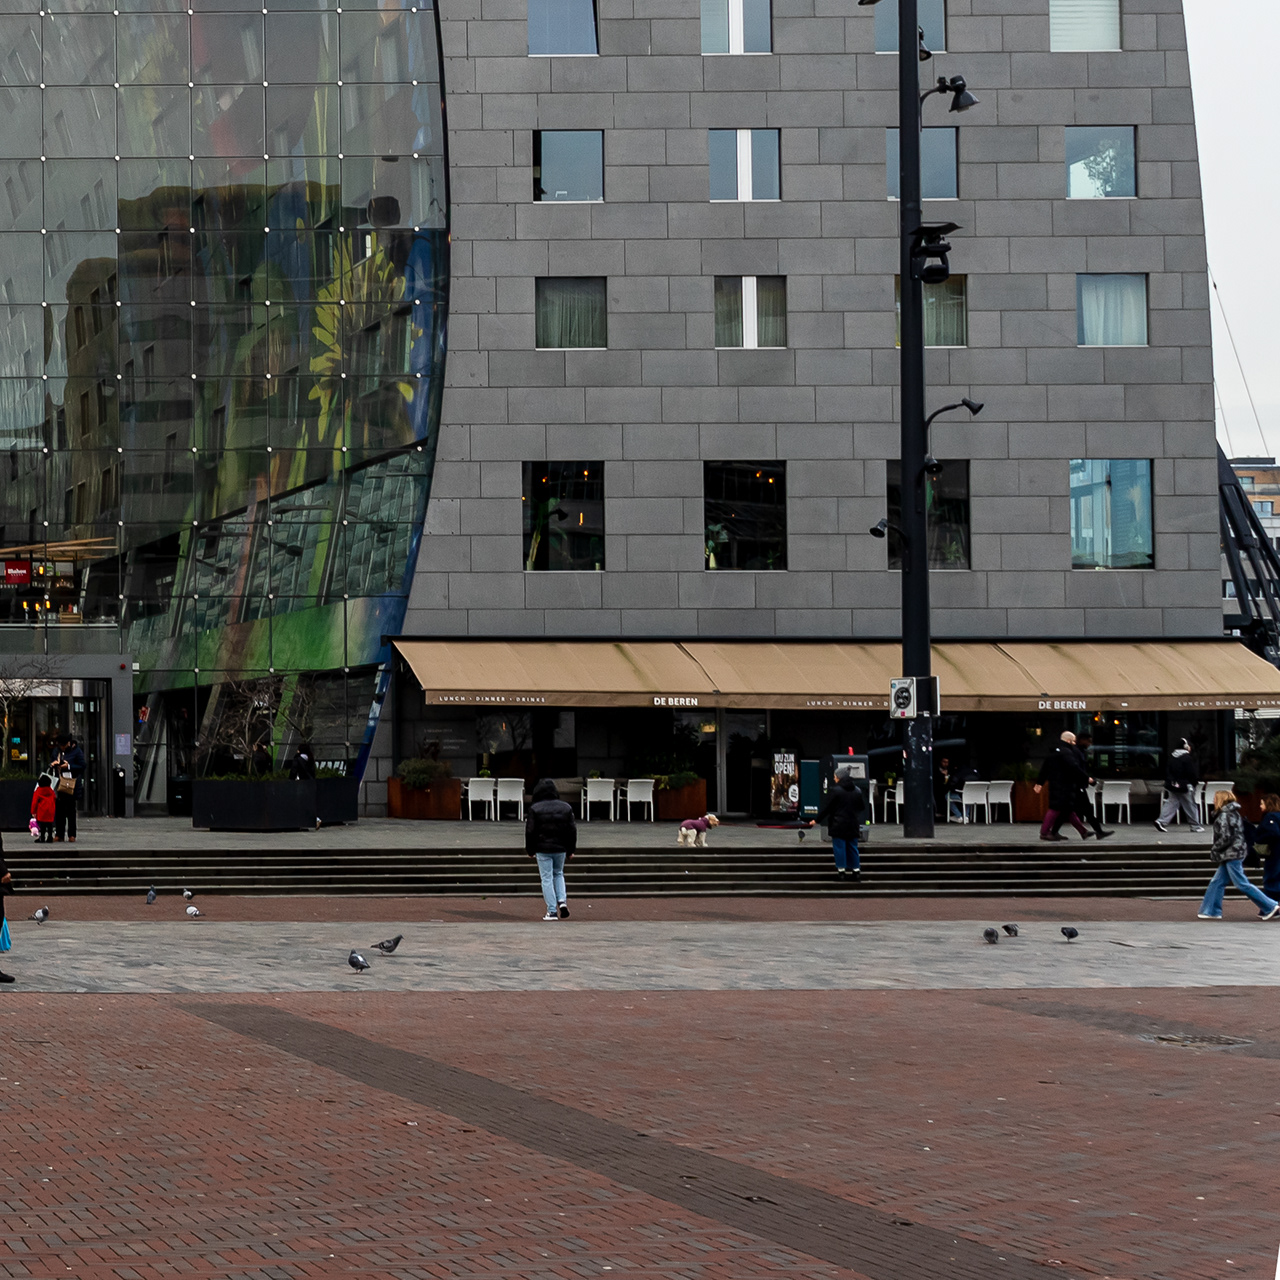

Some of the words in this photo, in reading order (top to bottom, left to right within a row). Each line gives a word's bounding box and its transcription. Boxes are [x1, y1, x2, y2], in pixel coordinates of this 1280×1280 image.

[653, 697, 666, 706] DE
[668, 697, 698, 706] BEREN
[1038, 700, 1052, 709] DE
[1053, 700, 1086, 709] BEREN
[774, 762, 794, 775] OPEN!
